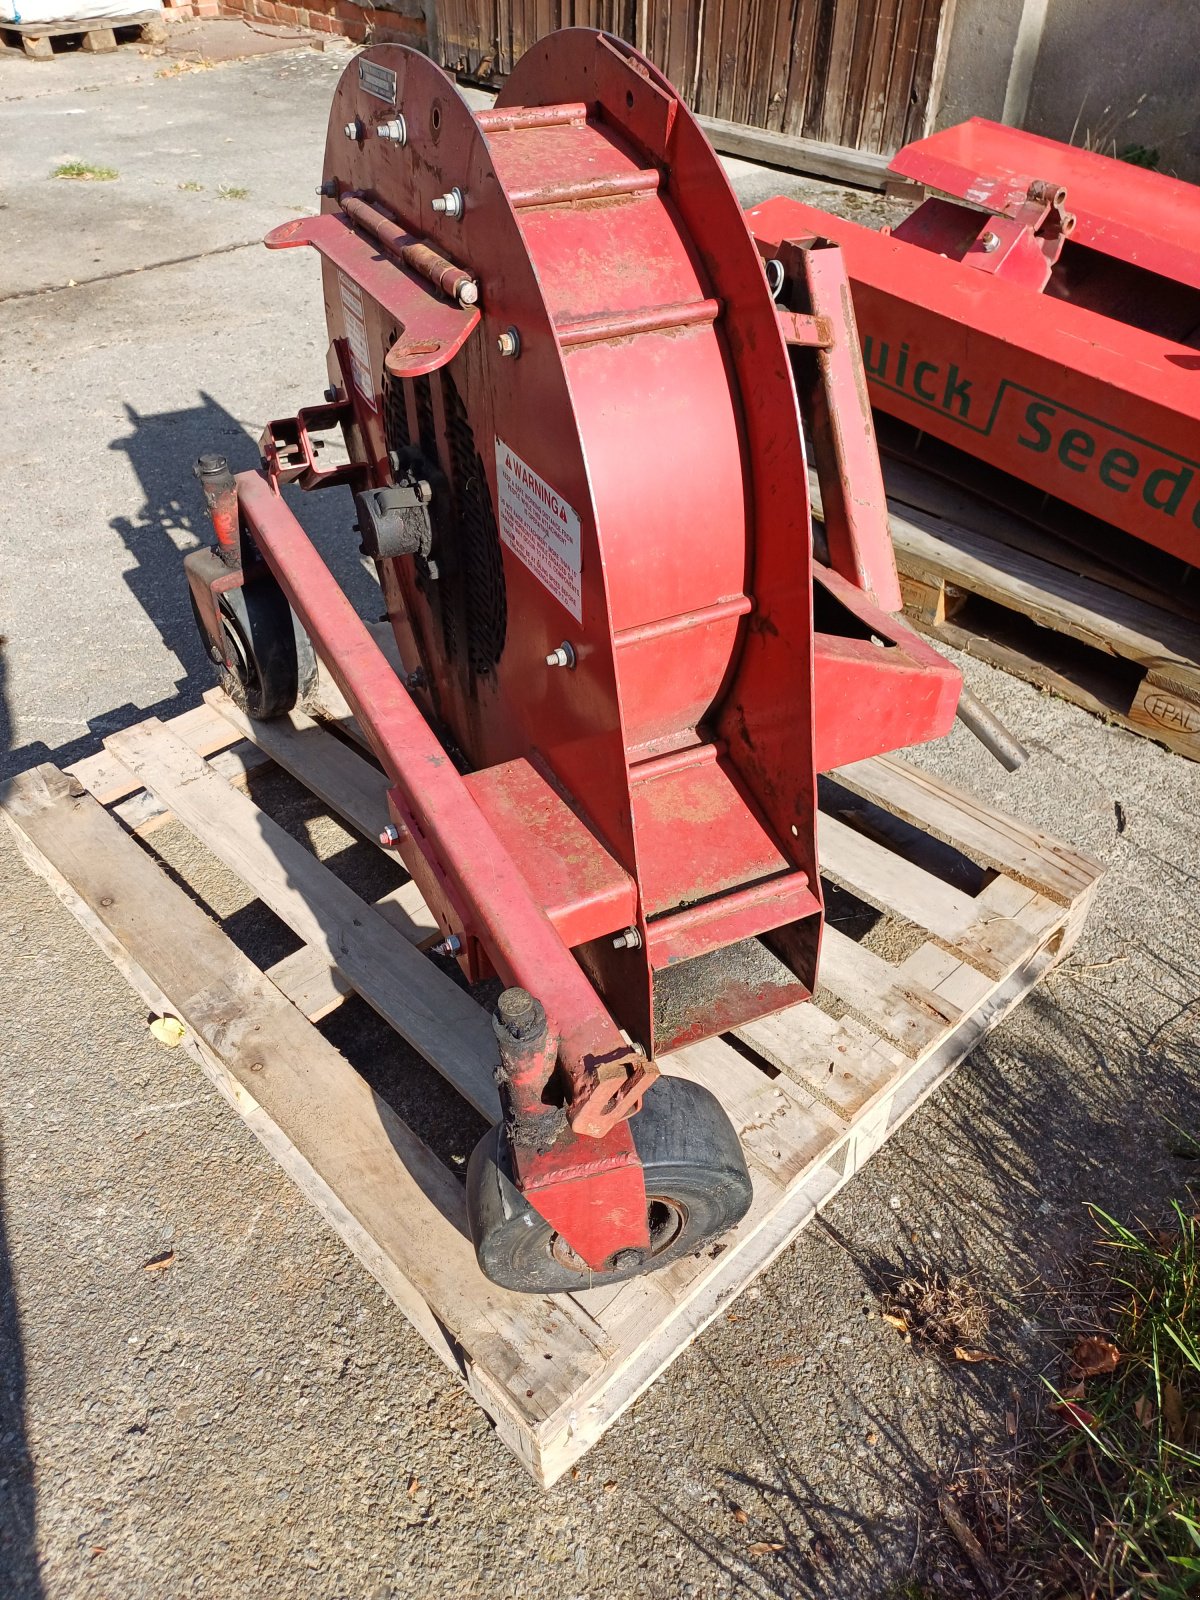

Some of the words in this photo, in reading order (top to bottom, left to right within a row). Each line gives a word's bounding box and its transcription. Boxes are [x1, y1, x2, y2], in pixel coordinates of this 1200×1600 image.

[863, 334, 973, 419] uick
[1016, 402, 1200, 532] Seed
[512, 458, 558, 516] WARNING
[507, 483, 520, 499] PEOPLE
[541, 517, 566, 546] ATTACHMENT
[542, 510, 561, 532] DISTANCE
[561, 529, 573, 544] FROM
[523, 520, 547, 548] ATTACHMENT
[548, 545, 559, 559] MORE
[560, 557, 570, 571] THAN
[1151, 697, 1193, 731] EPAL
